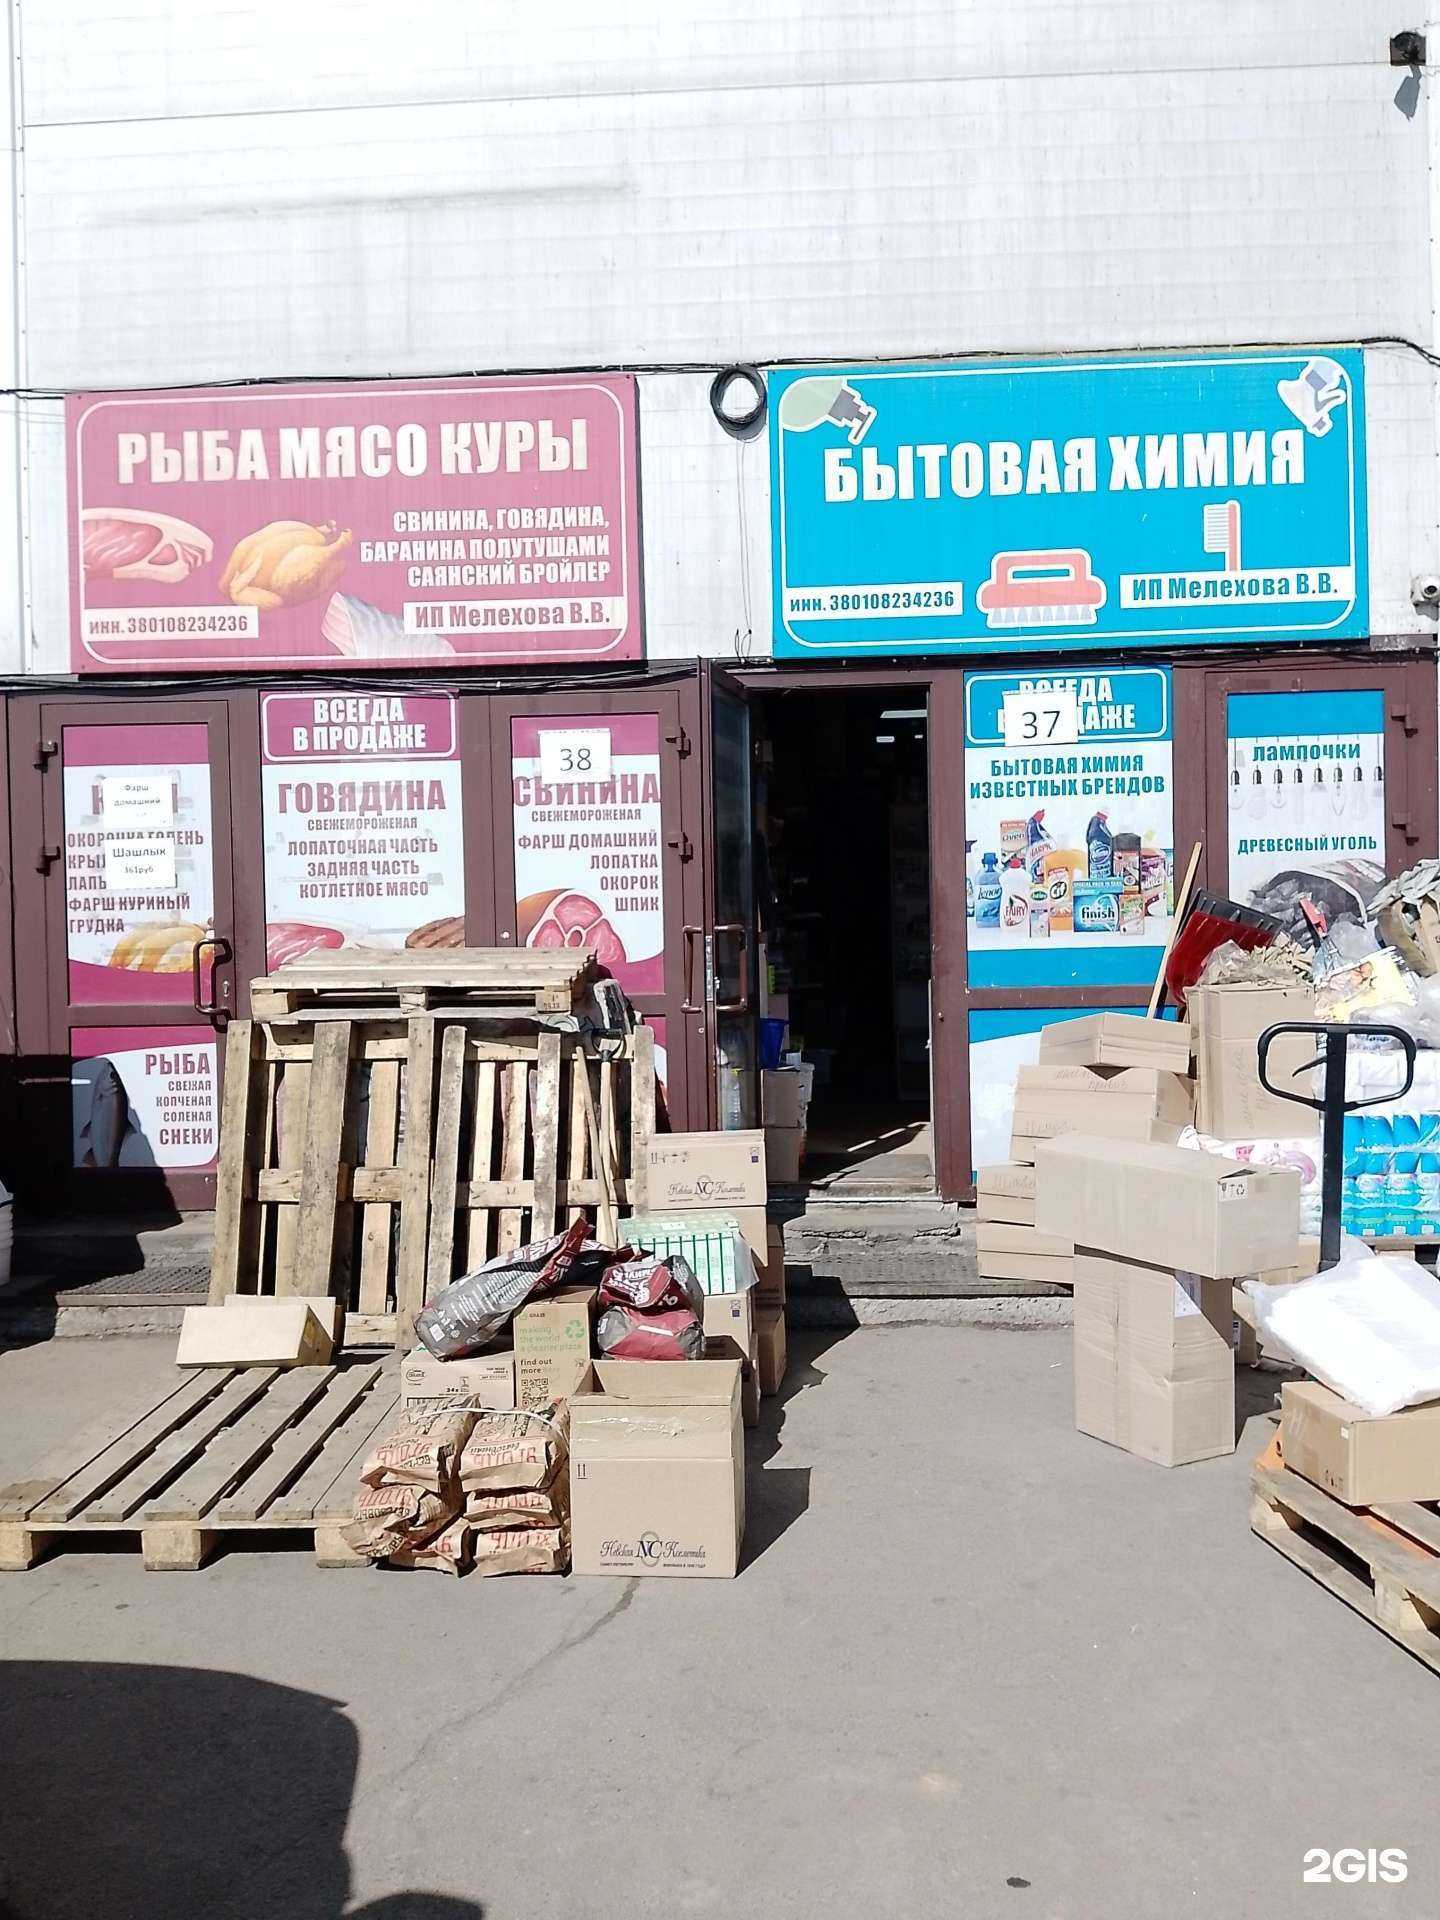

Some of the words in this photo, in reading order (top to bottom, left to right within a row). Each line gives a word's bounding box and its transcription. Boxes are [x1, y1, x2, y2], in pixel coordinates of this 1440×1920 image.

[117, 428, 269, 484] РЫБА
[280, 423, 428, 479] МЯСО
[440, 418, 588, 474] КУРЫ
[823, 437, 1097, 503] БЫТОВАЯ
[1108, 429, 1304, 491] ХИМИЯ
[393, 508, 493, 534] СВИНИНА,
[497, 506, 610, 531] ГОВЯДИНА,
[360, 538, 466, 563] БАРАНИНА
[470, 535, 609, 560] ПОЛУТУШАМИ
[407, 560, 516, 588] САЯНСКИЙ
[519, 557, 610, 584] БРОЙЛЕР
[1133, 579, 1163, 601] ИП
[1168, 575, 1290, 599] Мелехова
[1296, 574, 1339, 596] В.В.
[829, 590, 954, 611] 380108234236
[127, 615, 248, 634] 380108234236
[415, 606, 444, 628] ИП
[450, 602, 564, 628] Мелехова
[570, 603, 610, 625] В.В.
[313, 697, 404, 724] ВСЕГДА
[1022, 711, 1060, 739] 37
[293, 728, 309, 751] В
[313, 724, 426, 753] ПРОДАЖЕ
[560, 748, 592, 772] 38
[990, 757, 1077, 776] БЫТОВАЯ
[1081, 754, 1143, 773] ХИМИЯ
[514, 774, 660, 806] СВИНИНА
[970, 779, 1078, 799] ИЗВЕСТНЫХ
[1082, 776, 1165, 797] БРЕНДОВ
[278, 779, 446, 817] ГОВЯДИНА
[307, 817, 418, 831] СВЕЖЕМОРОЖЕНАЯ
[532, 808, 641, 822] СВЕЖЕМОРОЖЕНАЯ
[288, 840, 387, 856] ЛОПАТОЧНАЯ
[389, 838, 438, 854] ЧАСТЬ
[518, 834, 565, 849] ФАРШ
[569, 830, 657, 850] ДОМАШНИЙ
[1238, 834, 1329, 855] ДРЕВЕСНЫЙ
[1331, 836, 1377, 851] УГОЛЬ
[307, 861, 368, 879] ЗАДНЯЯ
[371, 860, 419, 875] ЧАСТЬ
[590, 854, 658, 869] ЛОПАТКА
[299, 882, 385, 898] КОТЛЕТНОЕ
[387, 881, 429, 896] МЯСО
[600, 875, 659, 891] ОКОРОК
[69, 897, 115, 911] ФАРШ
[119, 892, 190, 911] КУРИНЫЙ
[615, 897, 659, 912] ШПИК
[1005, 906, 1025, 917] FAIRY
[1081, 905, 1115, 919] finish
[69, 918, 125, 934] ГРУДКА
[145, 1053, 210, 1075] РЫБА
[168, 1080, 211, 1091] СВЕЖАЯ
[156, 1096, 212, 1107] КОПЧЕНАЯ
[163, 1111, 212, 1122] СОЛЕНАЯ
[159, 1128, 213, 1145] СНЕКИ
